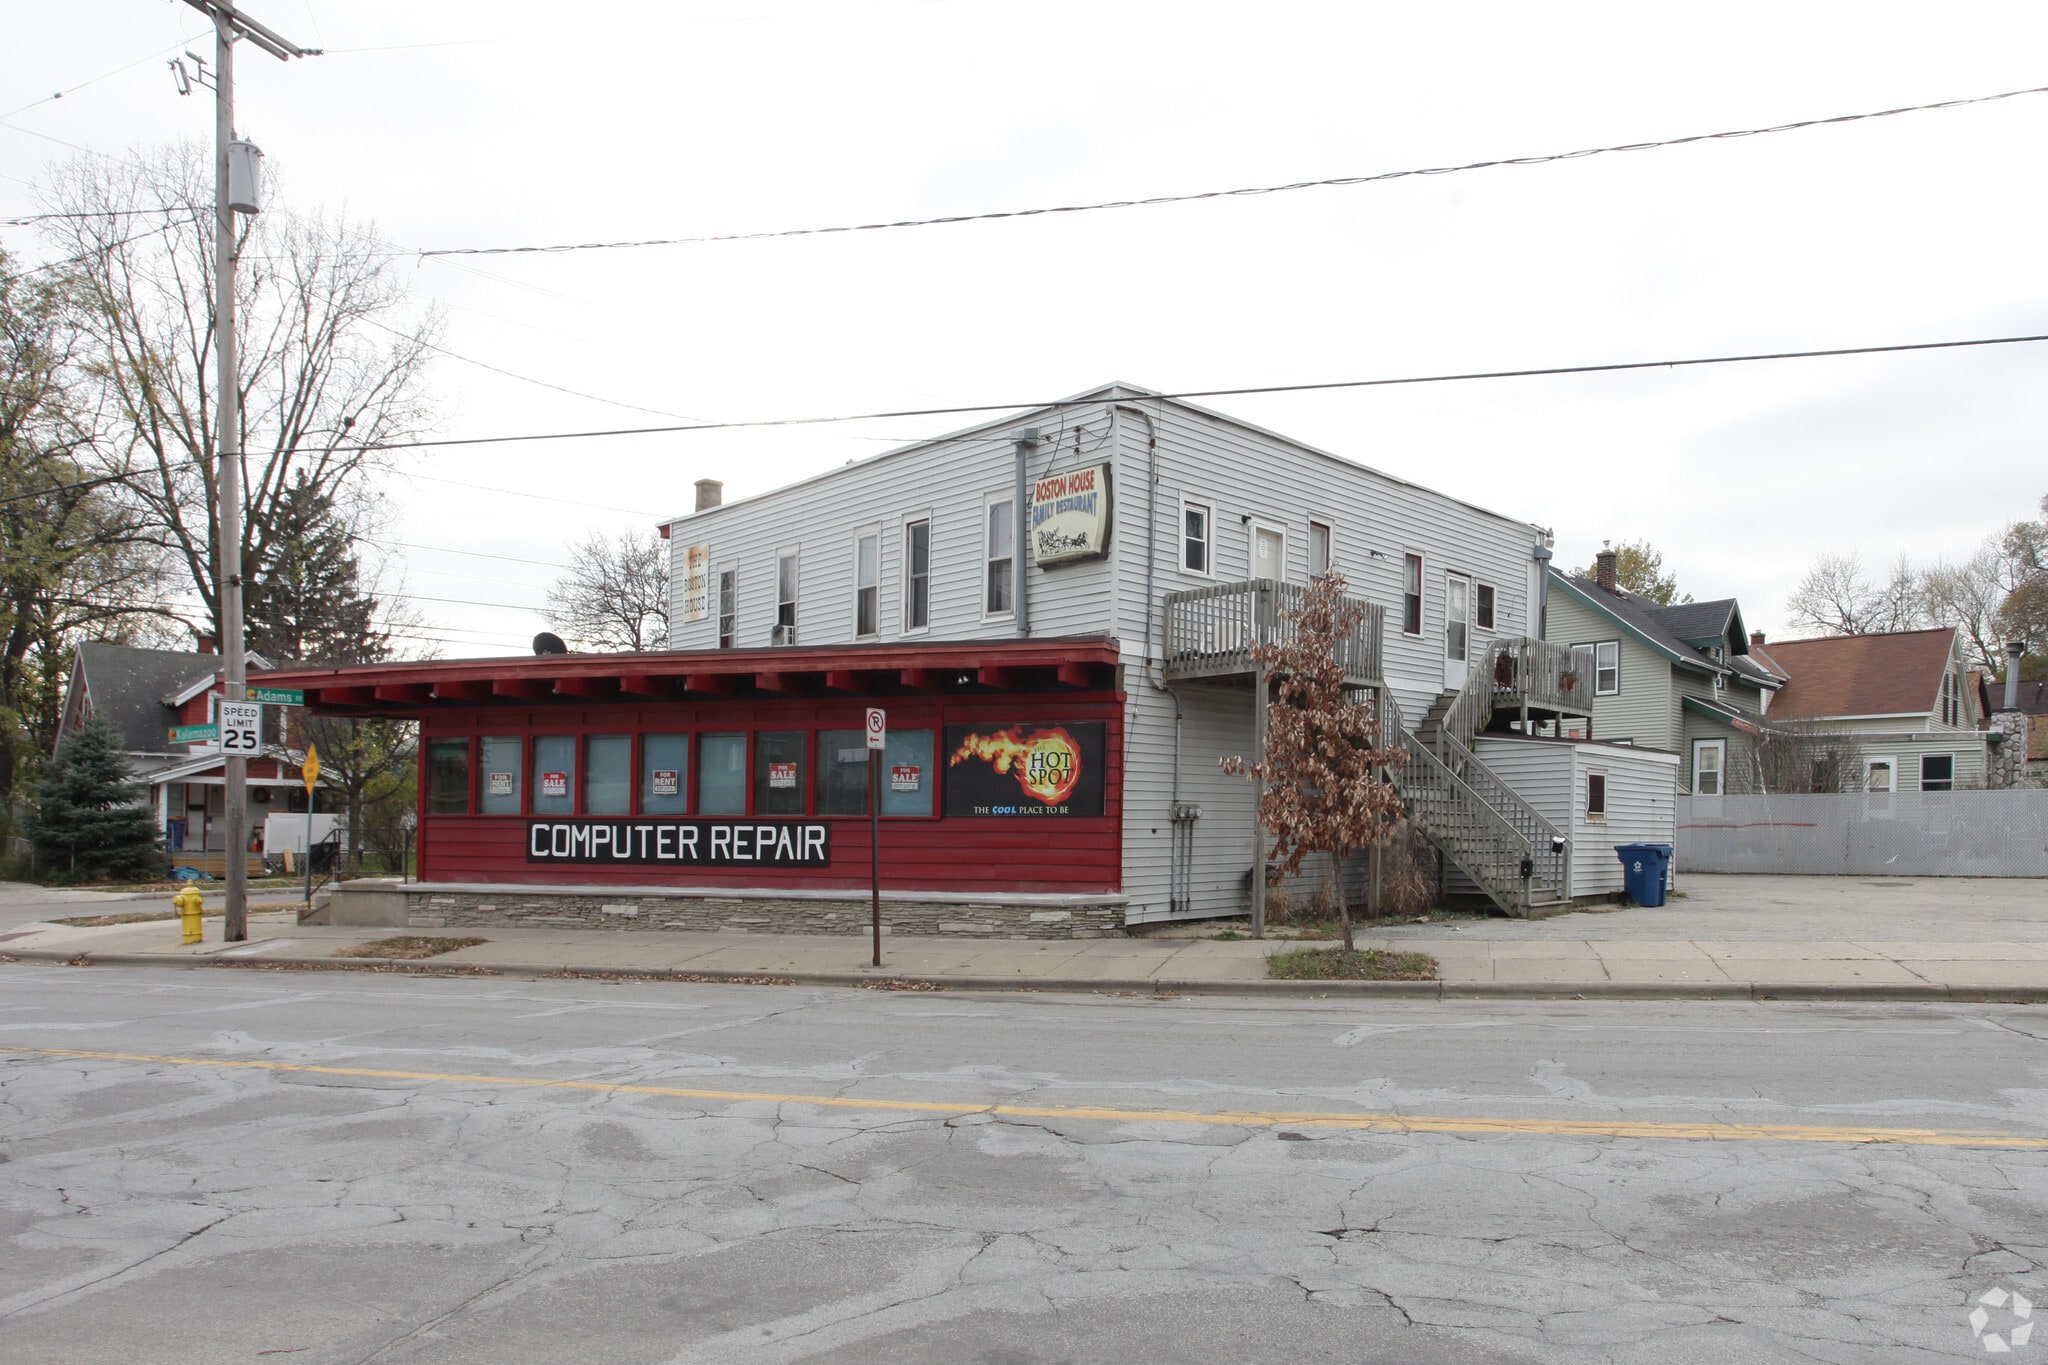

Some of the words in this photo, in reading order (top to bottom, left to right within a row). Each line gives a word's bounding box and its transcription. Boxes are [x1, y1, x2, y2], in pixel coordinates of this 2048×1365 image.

[1036, 477, 1067, 502] BOSTON
[1069, 470, 1095, 495] HOUSE
[1032, 502, 1055, 531] FAMILY
[1056, 492, 1098, 516] RESTAURANT
[684, 574, 706, 592] BOSTON
[684, 596, 705, 614] HOUSE
[256, 690, 292, 703] Adams
[223, 707, 258, 717] SPEED
[227, 719, 254, 728] LIMIT
[223, 729, 257, 749] 25
[1031, 752, 1072, 769] HOT
[654, 778, 676, 786] RENT
[770, 770, 796, 779] SALE
[892, 773, 918, 782] SALE
[1029, 768, 1073, 785] SPOT
[543, 779, 566, 787] SALE
[973, 806, 990, 815] THE
[992, 805, 1017, 815] COOL
[1019, 806, 1044, 815] PLACE
[1045, 806, 1058, 815] TO
[1059, 806, 1069, 815] BE
[531, 823, 698, 860] COMPUTER
[711, 825, 826, 861] REPAIR
